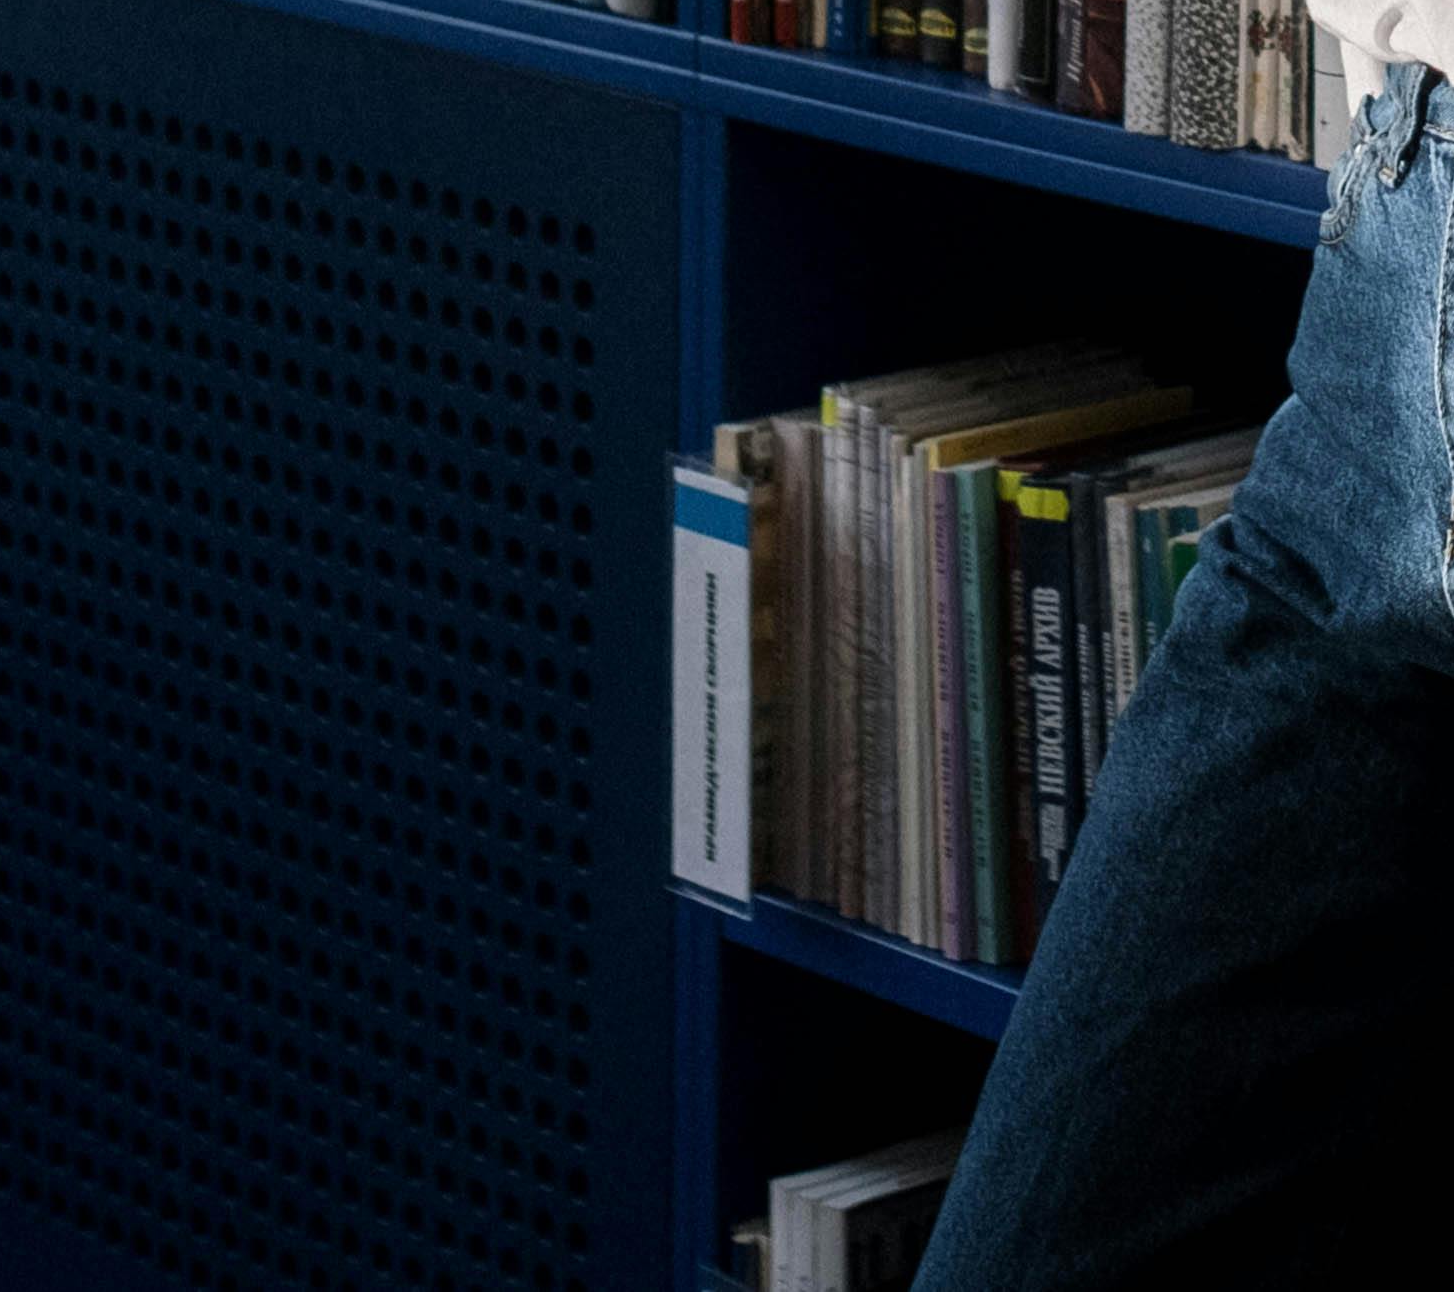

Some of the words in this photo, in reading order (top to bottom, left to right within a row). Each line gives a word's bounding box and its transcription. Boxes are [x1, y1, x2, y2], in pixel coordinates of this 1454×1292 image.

[704, 571, 719, 689] СБОРНИКИ
[1029, 585, 1064, 670] АРХИВ
[1028, 675, 1066, 797] НЕВСКИЙ
